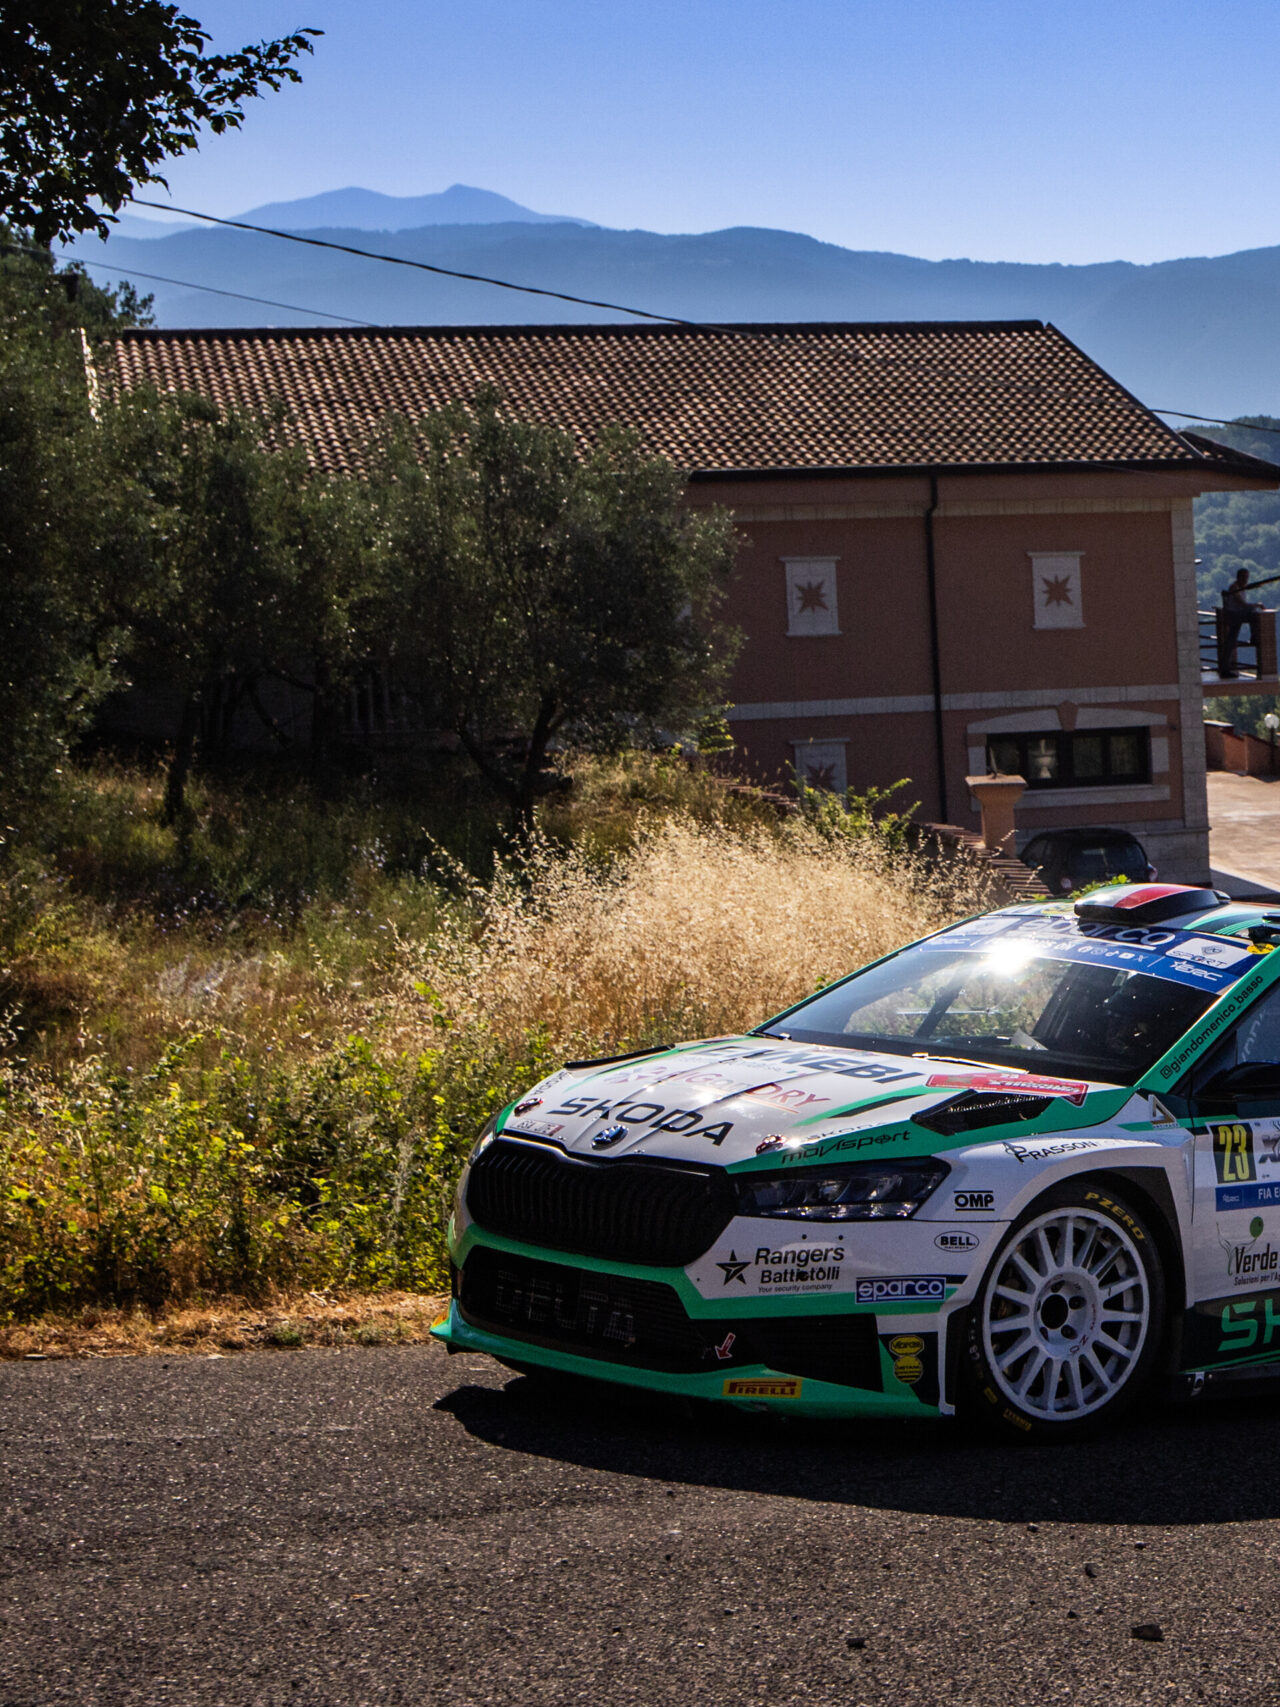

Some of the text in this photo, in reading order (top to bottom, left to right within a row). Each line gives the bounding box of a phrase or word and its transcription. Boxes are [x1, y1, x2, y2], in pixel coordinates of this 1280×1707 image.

[1160, 975, 1264, 1079] @giandomenico_basso
[1218, 1124, 1250, 1182] 23
[955, 1193, 995, 1208] OMP
[1258, 1188, 1272, 1200] FIA
[940, 1236, 973, 1246] BELL
[755, 1247, 845, 1268] Rangers
[1235, 1244, 1278, 1274] Verde
[775, 1284, 800, 1293] security
[802, 1283, 833, 1292] company
[1234, 1276, 1260, 1286] Soluzioni
[1260, 1275, 1270, 1284] per
[858, 1279, 944, 1299] sparco
[728, 1381, 796, 1395] PIRELLI
